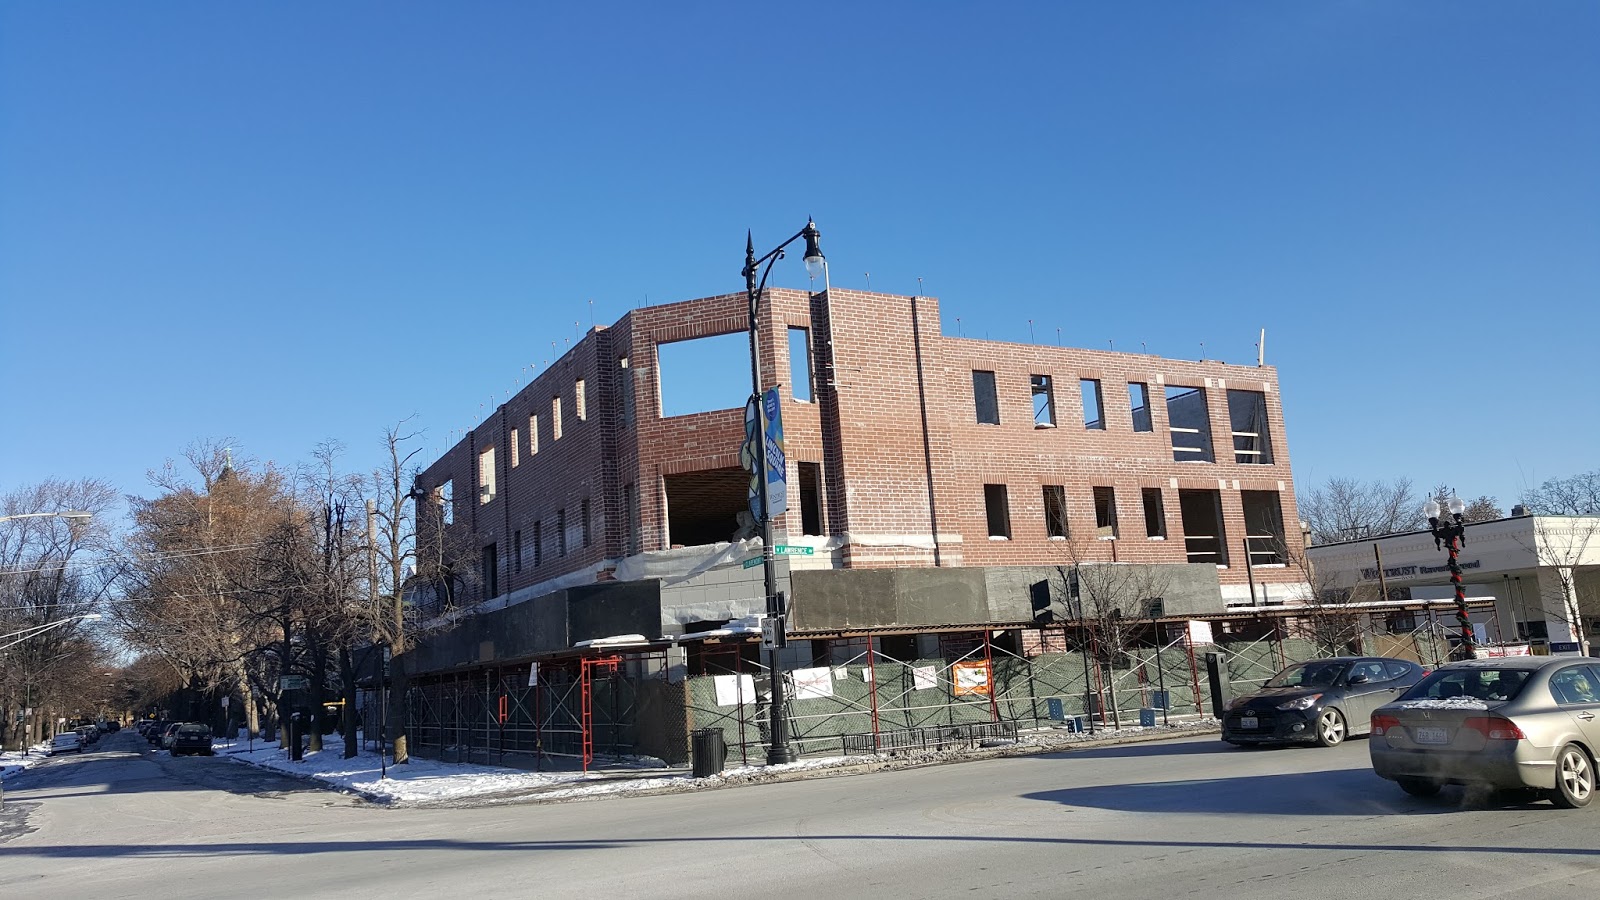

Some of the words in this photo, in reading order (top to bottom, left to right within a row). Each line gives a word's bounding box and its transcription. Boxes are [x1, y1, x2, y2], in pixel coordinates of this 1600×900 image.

[766, 436, 785, 463] LINCOLN
[766, 450, 785, 477] SQUARE
[1420, 560, 1480, 575] Ravenood
[763, 620, 772, 628] ONE
[763, 628, 772, 636] WAY
